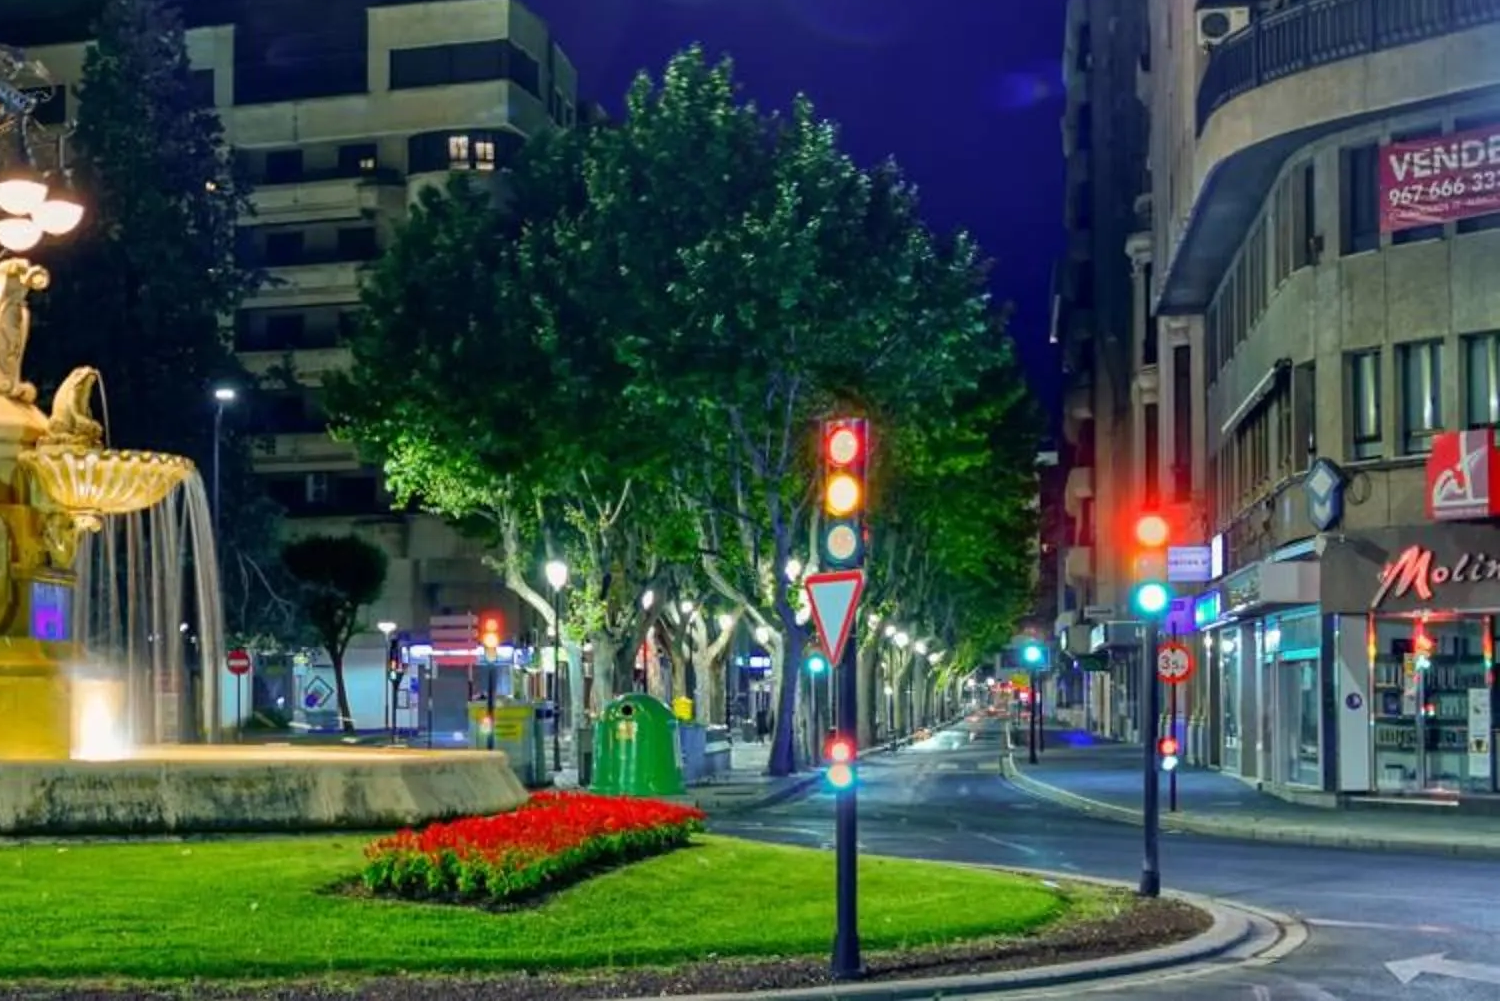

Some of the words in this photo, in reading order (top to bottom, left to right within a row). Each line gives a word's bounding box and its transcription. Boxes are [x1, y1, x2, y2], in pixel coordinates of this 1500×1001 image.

[1389, 184, 1424, 206] 967
[1429, 178, 1465, 200] 666
[1471, 169, 1500, 192] 33
